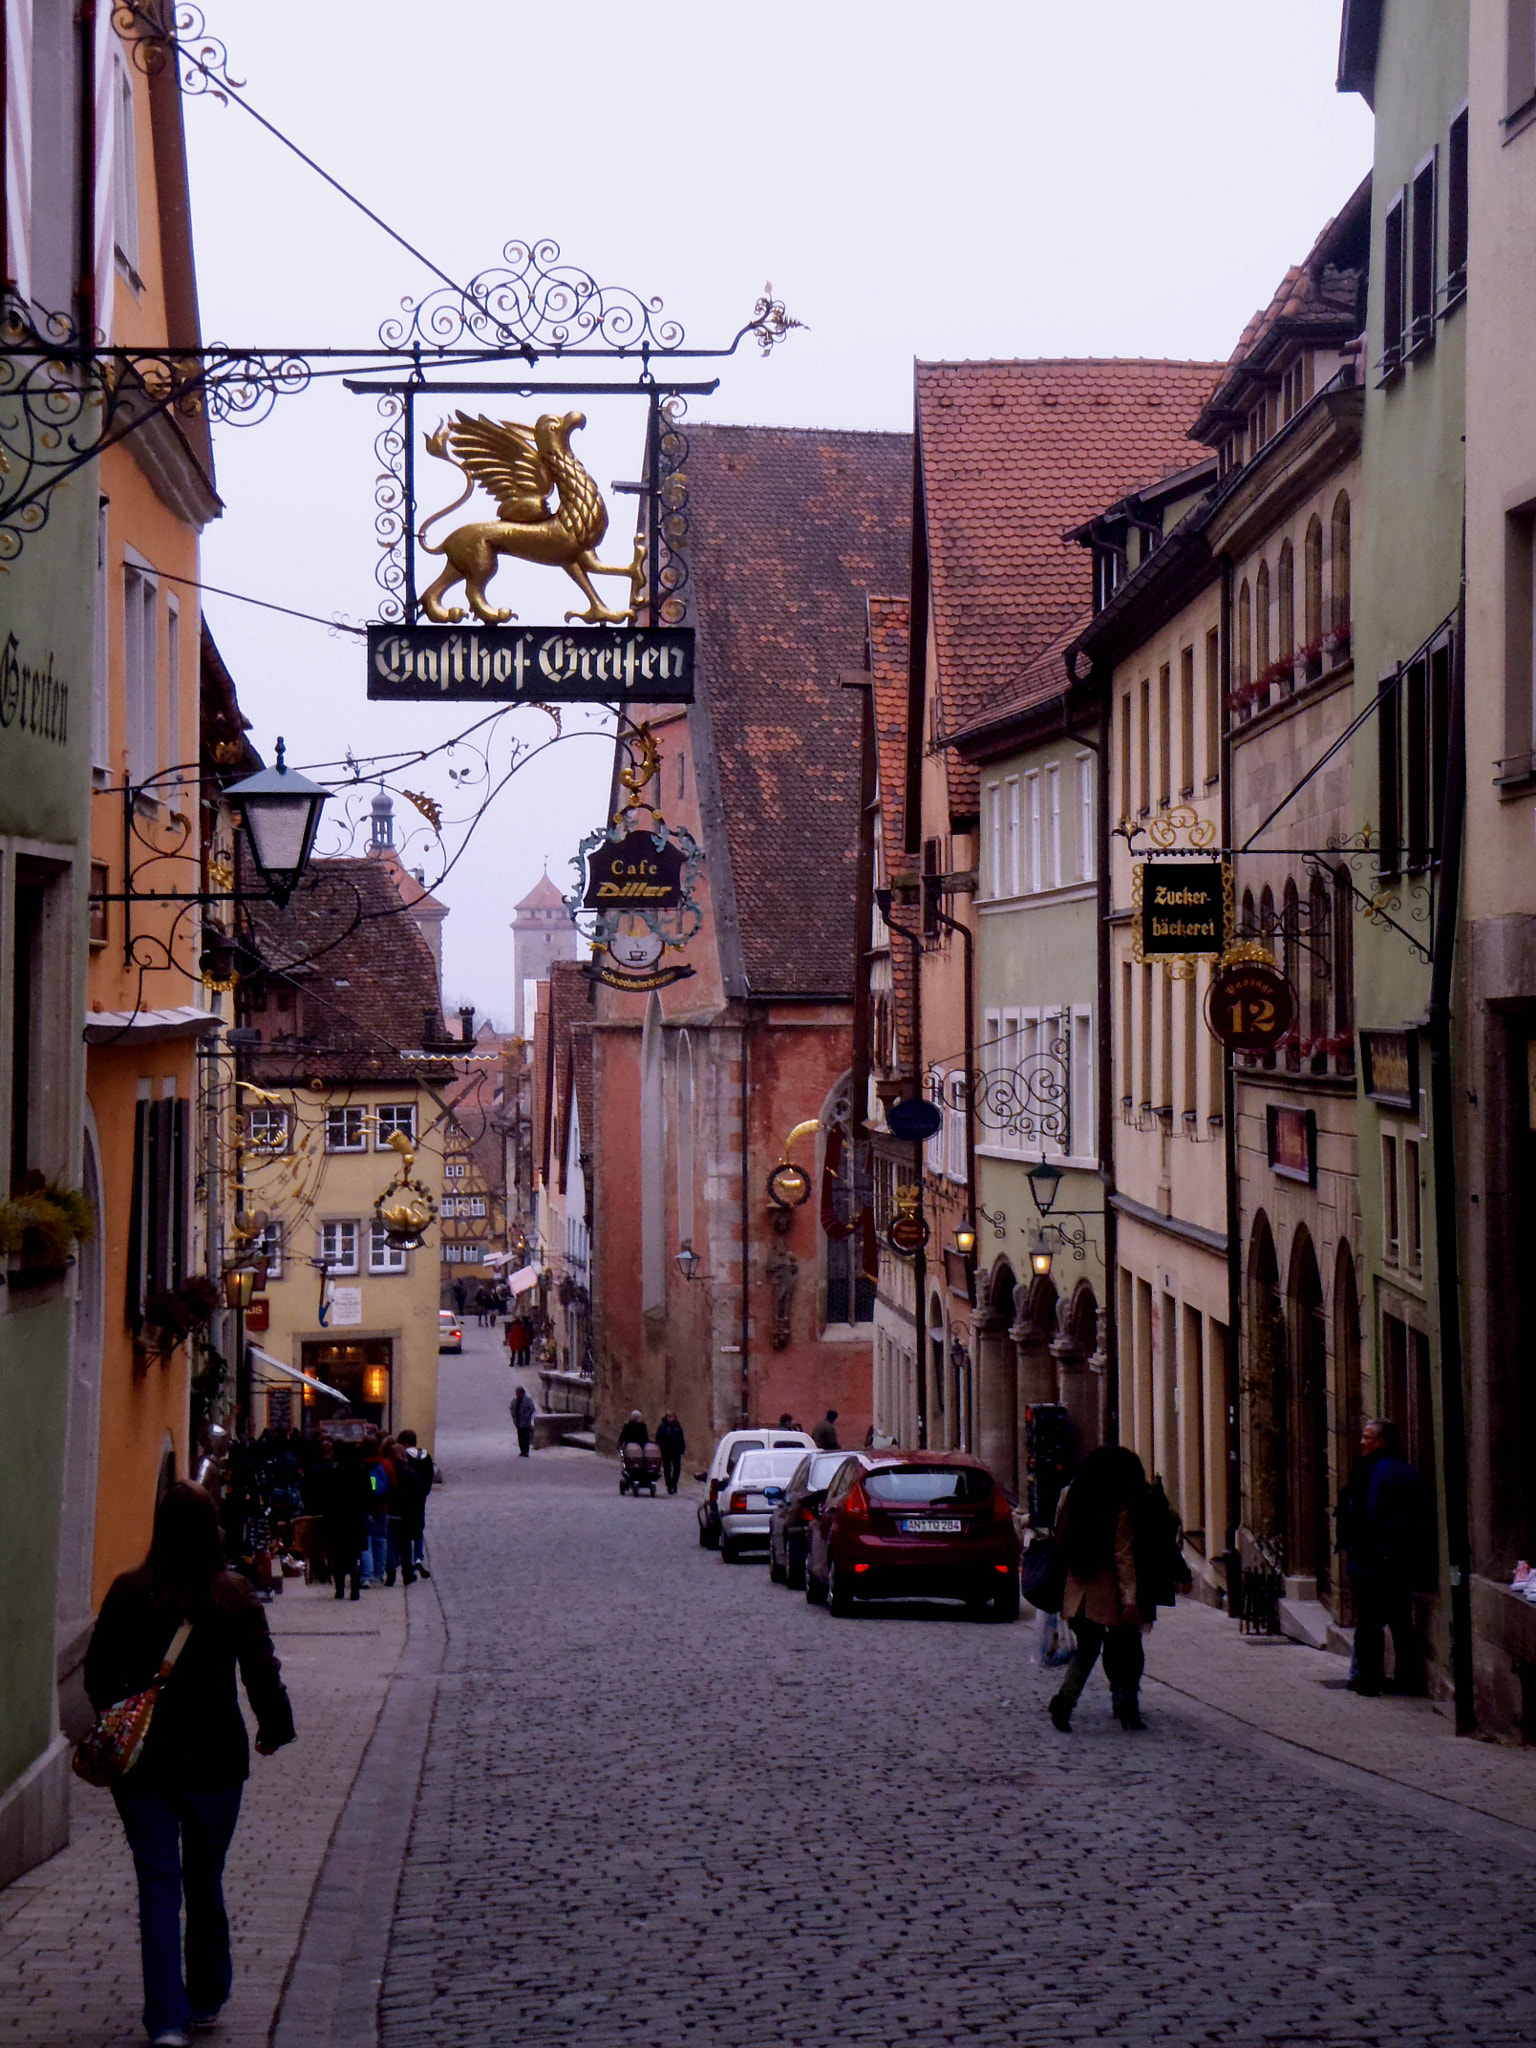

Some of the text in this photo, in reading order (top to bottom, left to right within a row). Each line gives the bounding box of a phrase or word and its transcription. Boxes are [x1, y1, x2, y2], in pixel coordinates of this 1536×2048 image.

[539, 633, 685, 689] Greifen
[611, 860, 658, 875] Cafe
[596, 881, 673, 897] Diller
[1154, 885, 1211, 906] Zucker-
[1152, 916, 1215, 937] bäckerei
[1228, 999, 1275, 1033] 12
